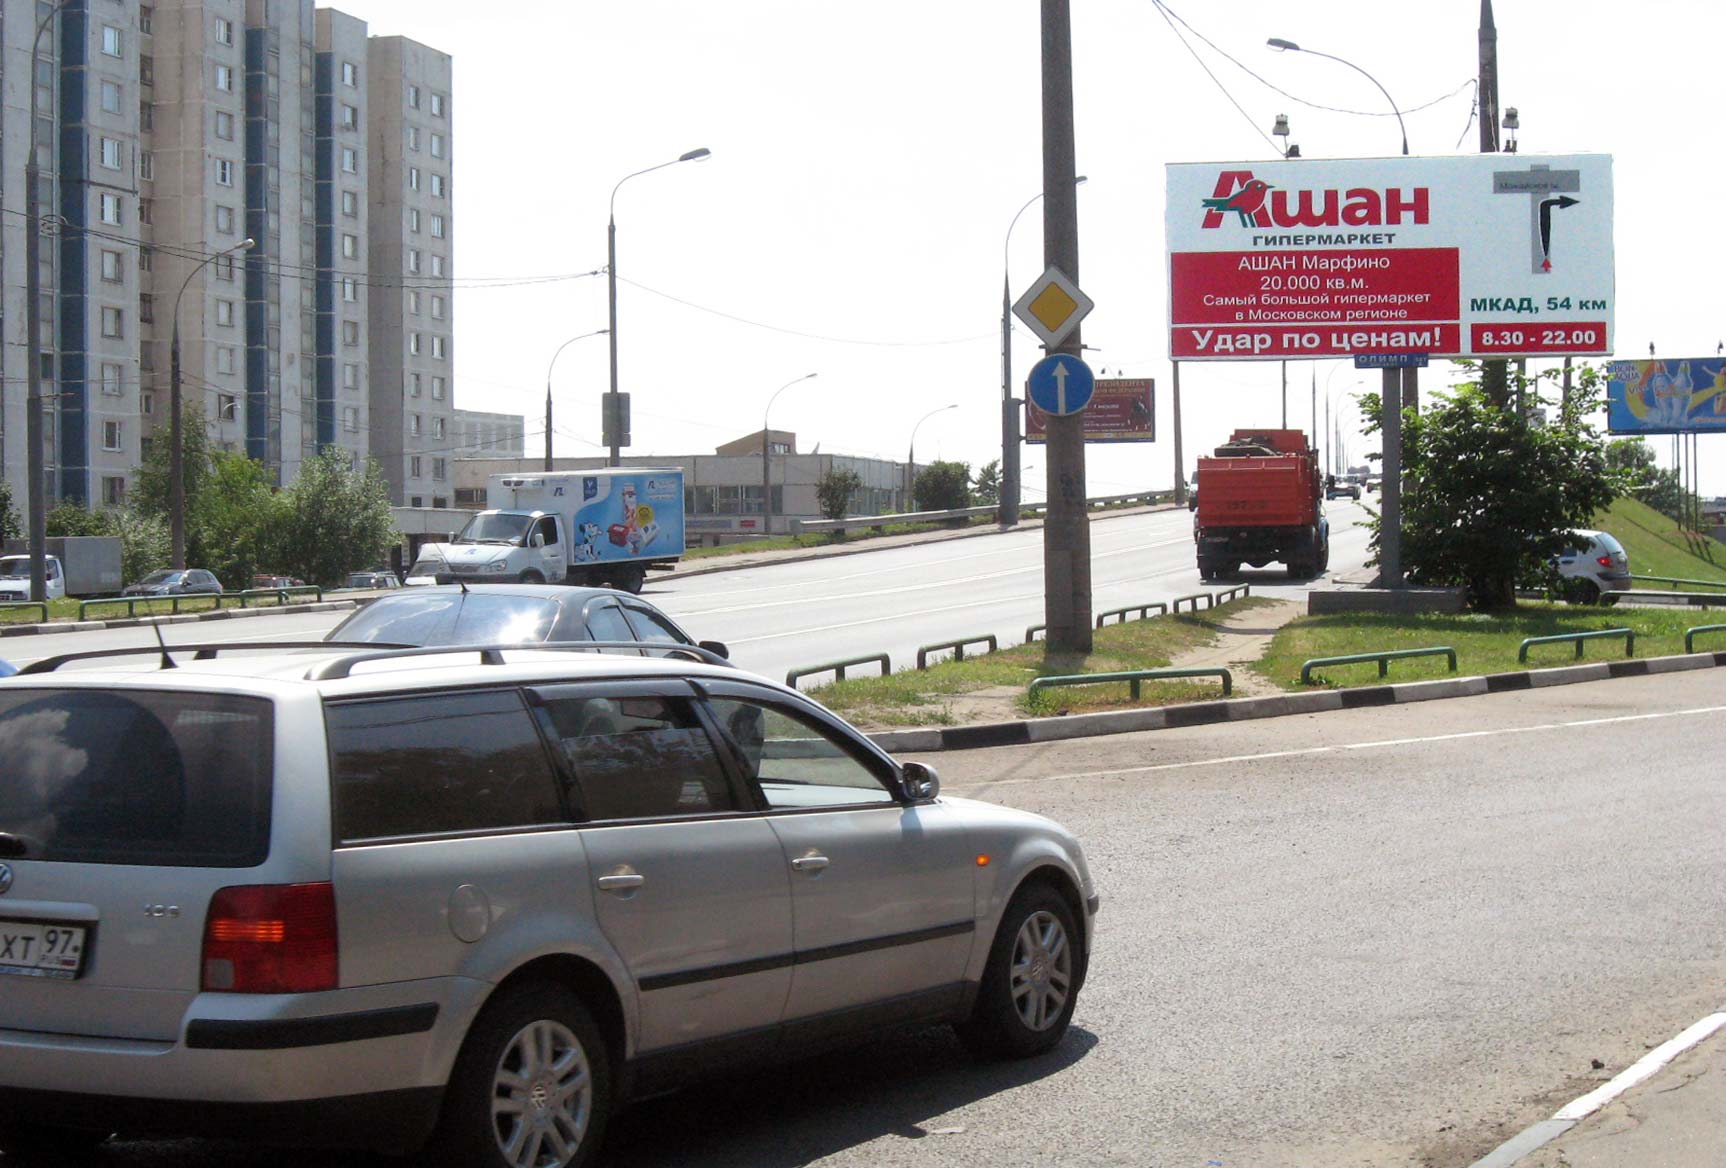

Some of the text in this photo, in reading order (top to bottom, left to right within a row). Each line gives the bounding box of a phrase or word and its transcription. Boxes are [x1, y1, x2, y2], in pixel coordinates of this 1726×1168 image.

[1252, 233, 1396, 247] ГИПЕРМАРКЕТ
[1238, 255, 1391, 272] АШАН Марфино
[1260, 276, 1370, 291] 20.000 кв.м.
[1203, 292, 1431, 308] Самый большой гипермаркет
[1470, 296, 1607, 314] МКАД, 54 км
[1235, 308, 1408, 323] в Московском регионе
[1191, 327, 1442, 354] Удар по ценам!
[1482, 331, 1524, 346] 8.30
[1542, 330, 1597, 345] 22.00
[1358, 354, 1409, 363] ОЛИМП
[45, 928, 74, 954] 97
